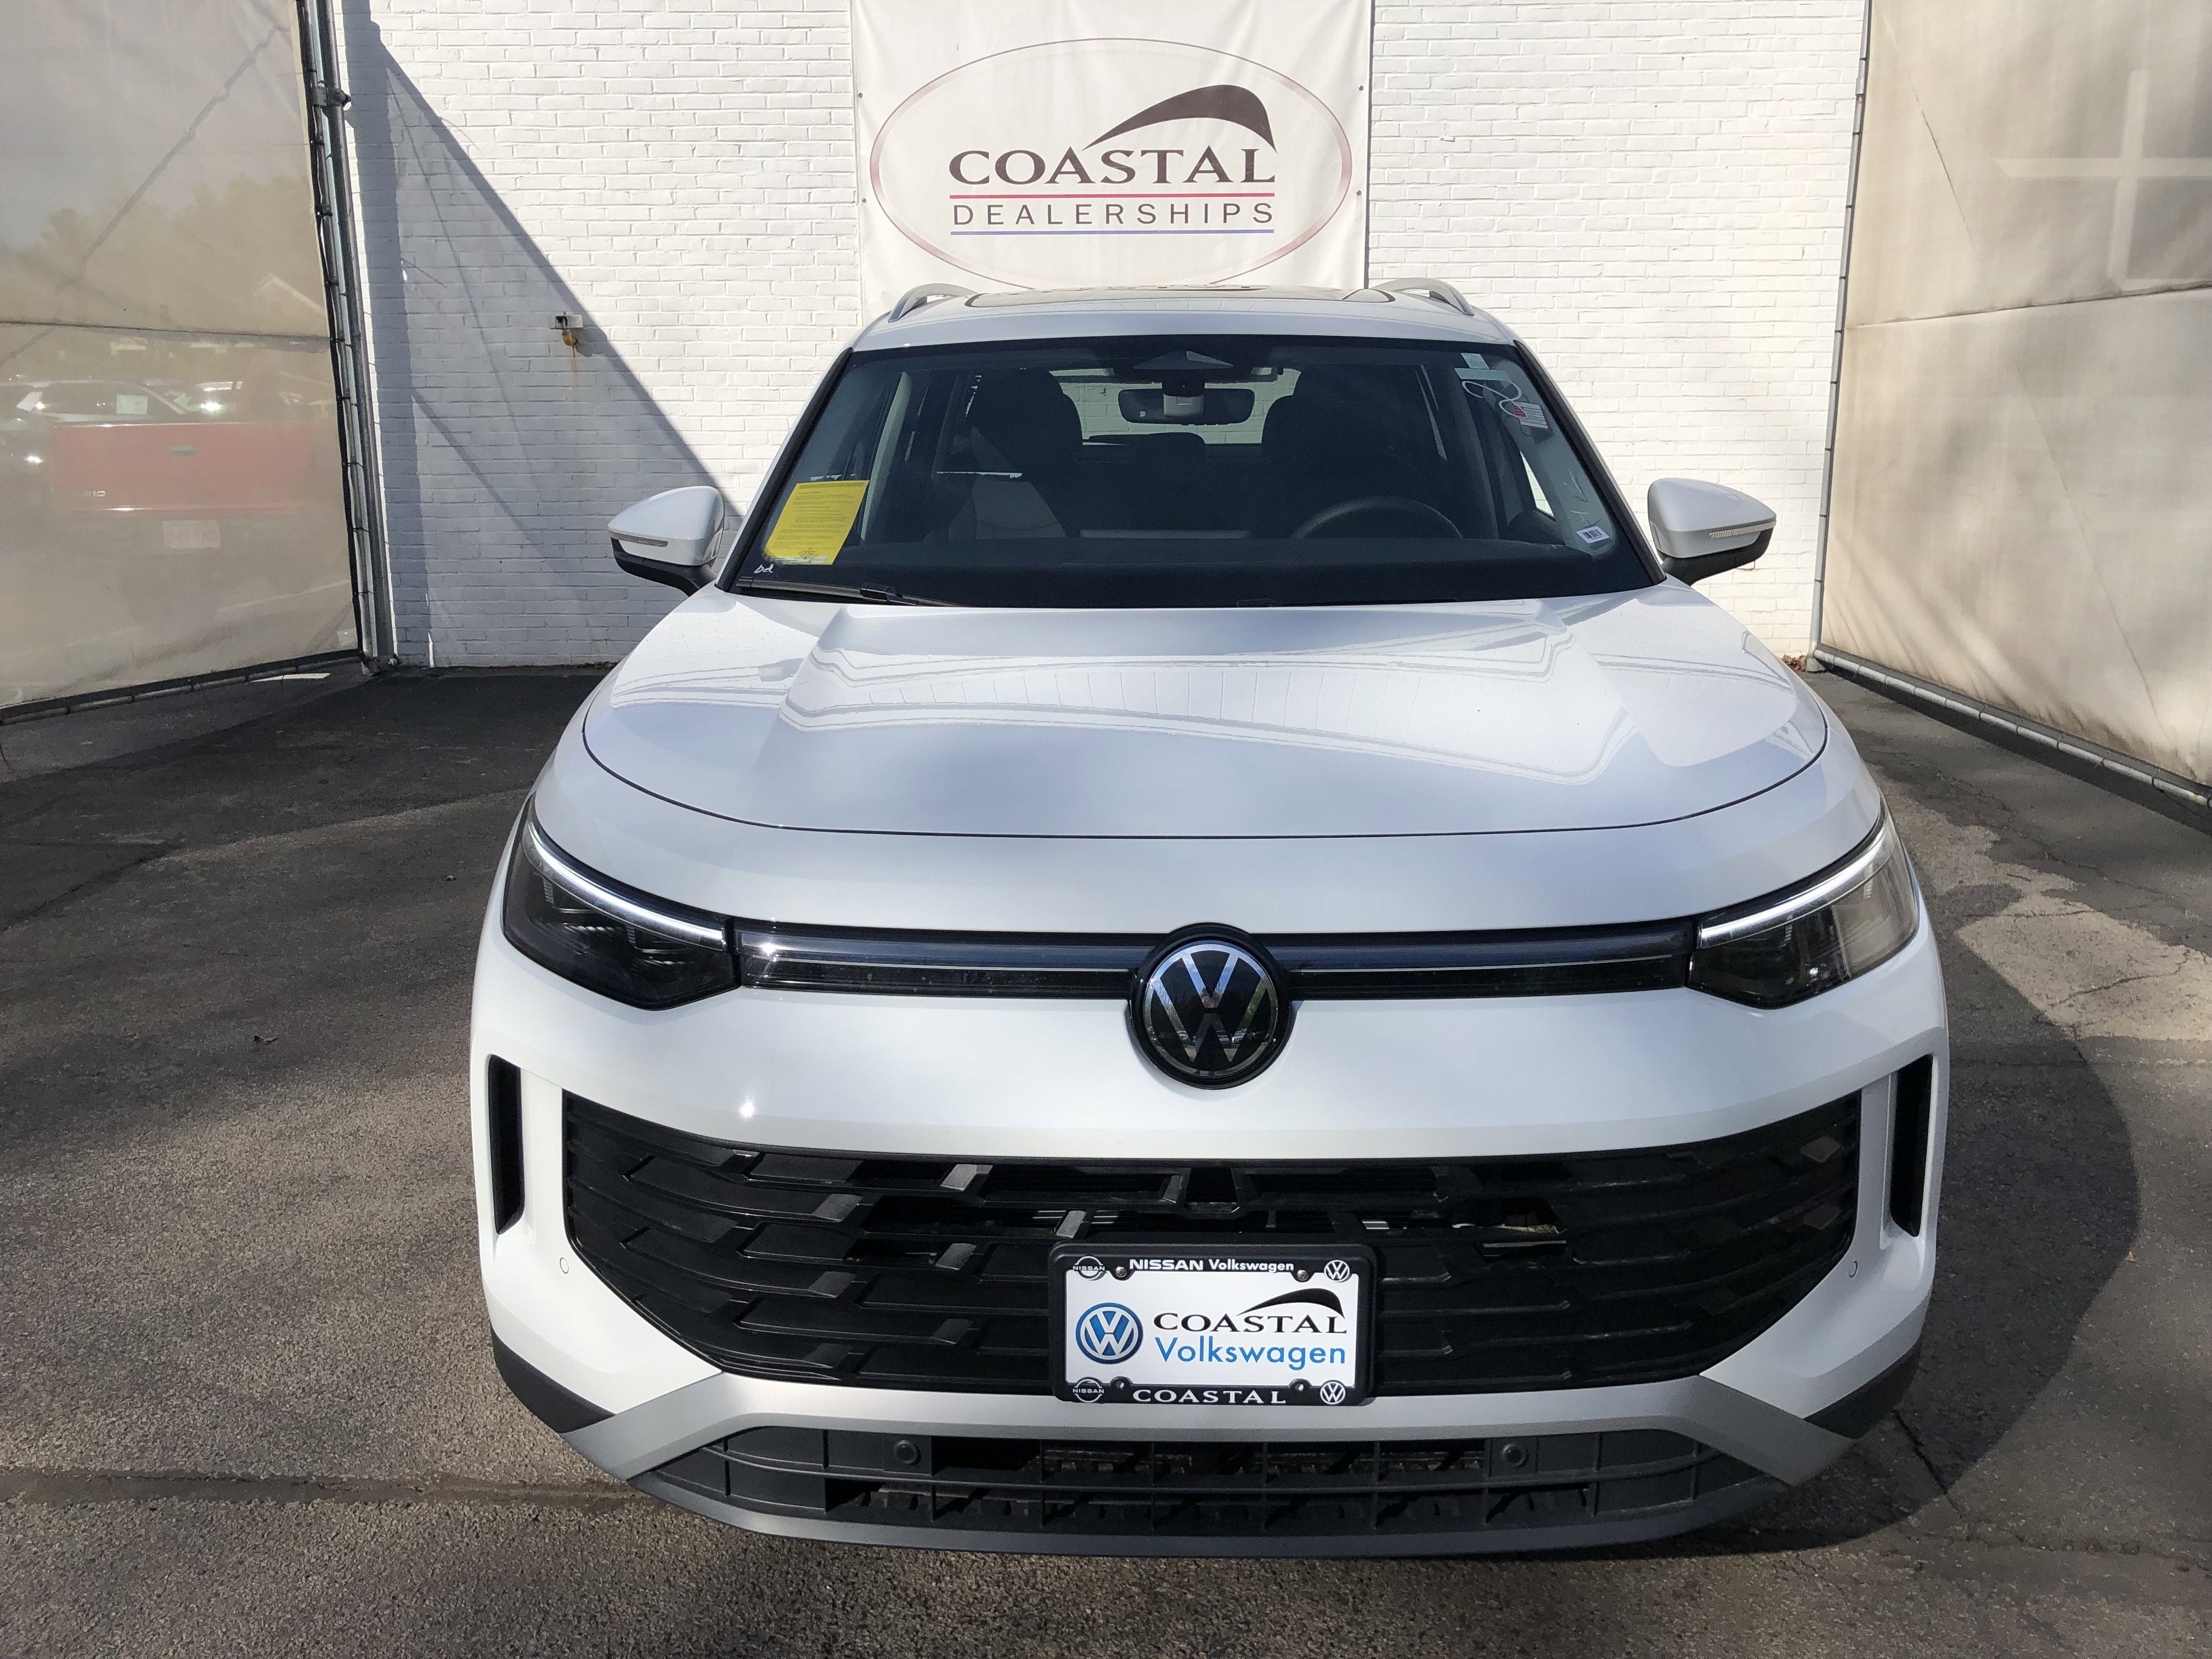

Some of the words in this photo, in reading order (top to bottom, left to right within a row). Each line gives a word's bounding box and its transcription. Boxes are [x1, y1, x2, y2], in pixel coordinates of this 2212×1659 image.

[949, 145, 1275, 185] COASTAL
[953, 202, 1274, 226] DEALERSHIPS
[1130, 1259, 1203, 1270] NISSAN
[1208, 1259, 1294, 1273] Volkswagen
[1153, 1313, 1347, 1334] COASTAL
[1154, 1335, 1346, 1370] Volkswagen
[1133, 1389, 1286, 1404] COASTAL
